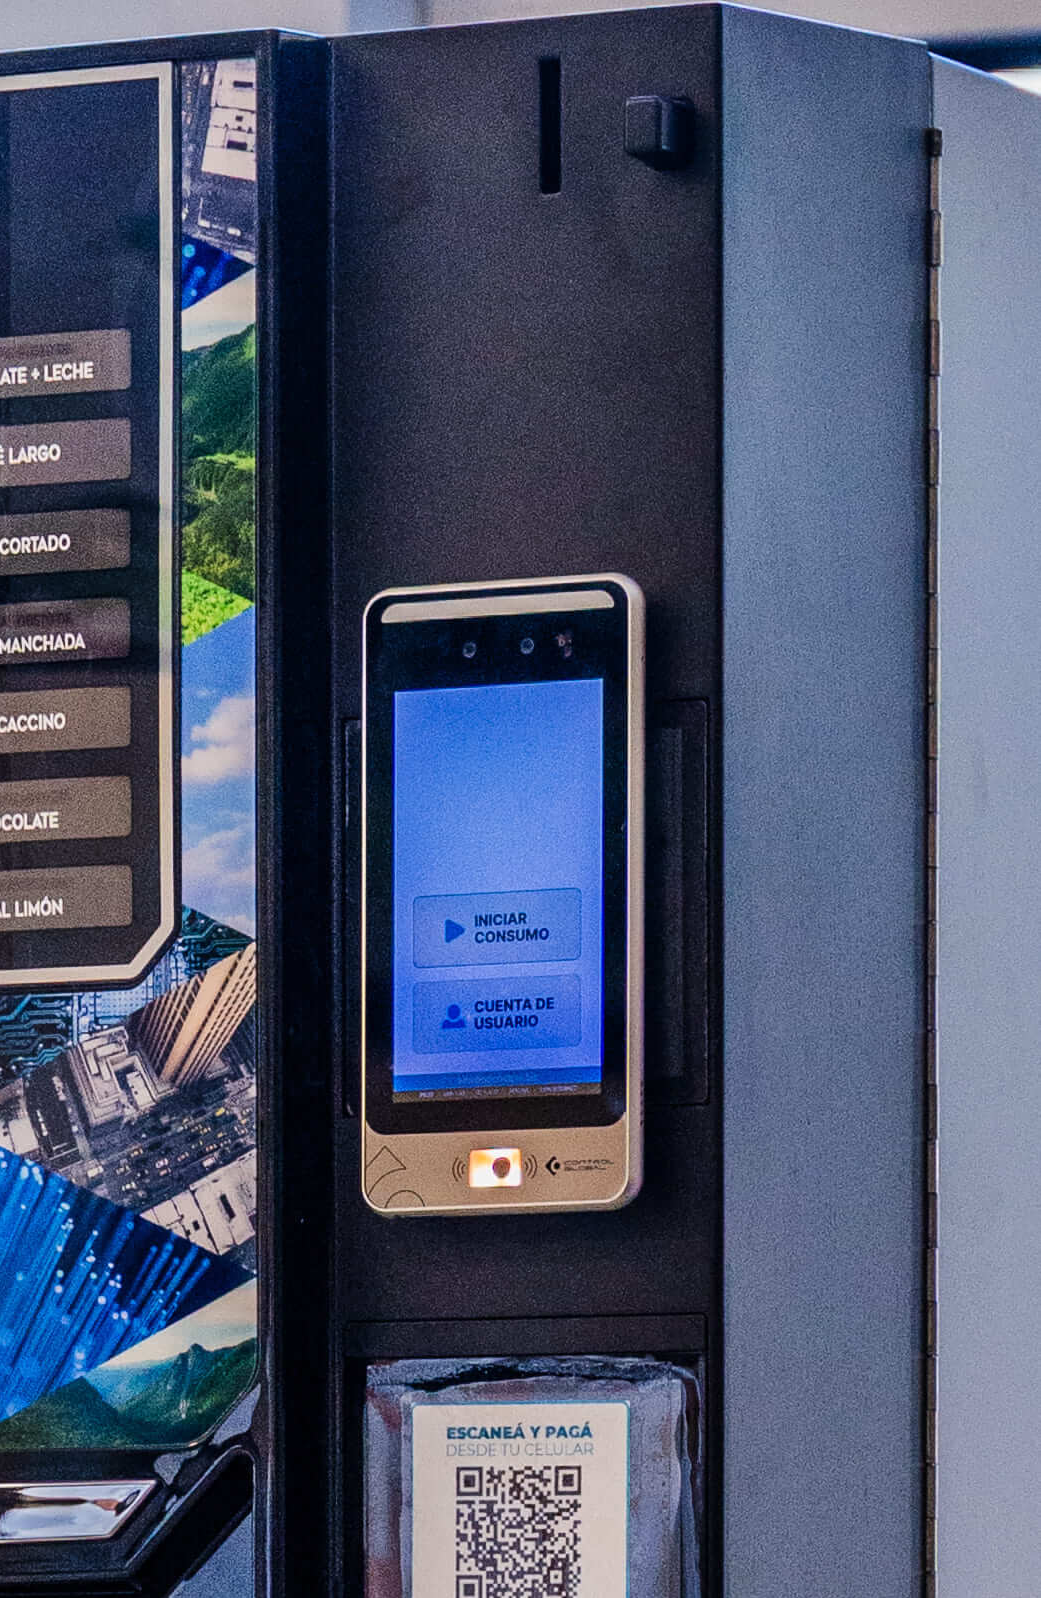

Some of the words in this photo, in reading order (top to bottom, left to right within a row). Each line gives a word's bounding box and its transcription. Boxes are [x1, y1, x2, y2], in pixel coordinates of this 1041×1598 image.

[44, 361, 94, 382] LECHE
[8, 443, 61, 465] LARGO
[15, 894, 64, 917] LIMÓN
[474, 912, 527, 928] INICIAR
[474, 927, 550, 944] CONSUMO
[474, 998, 533, 1014] CUENTA
[535, 997, 555, 1011] DE
[474, 1014, 539, 1031] USUARIO
[446, 1422, 525, 1440] ESCANEÁ
[530, 1426, 541, 1439] Y
[546, 1421, 592, 1439] PAGÁ
[446, 1443, 496, 1457] DESDE
[502, 1443, 520, 1457] TU
[524, 1442, 594, 1457] CELULAR
